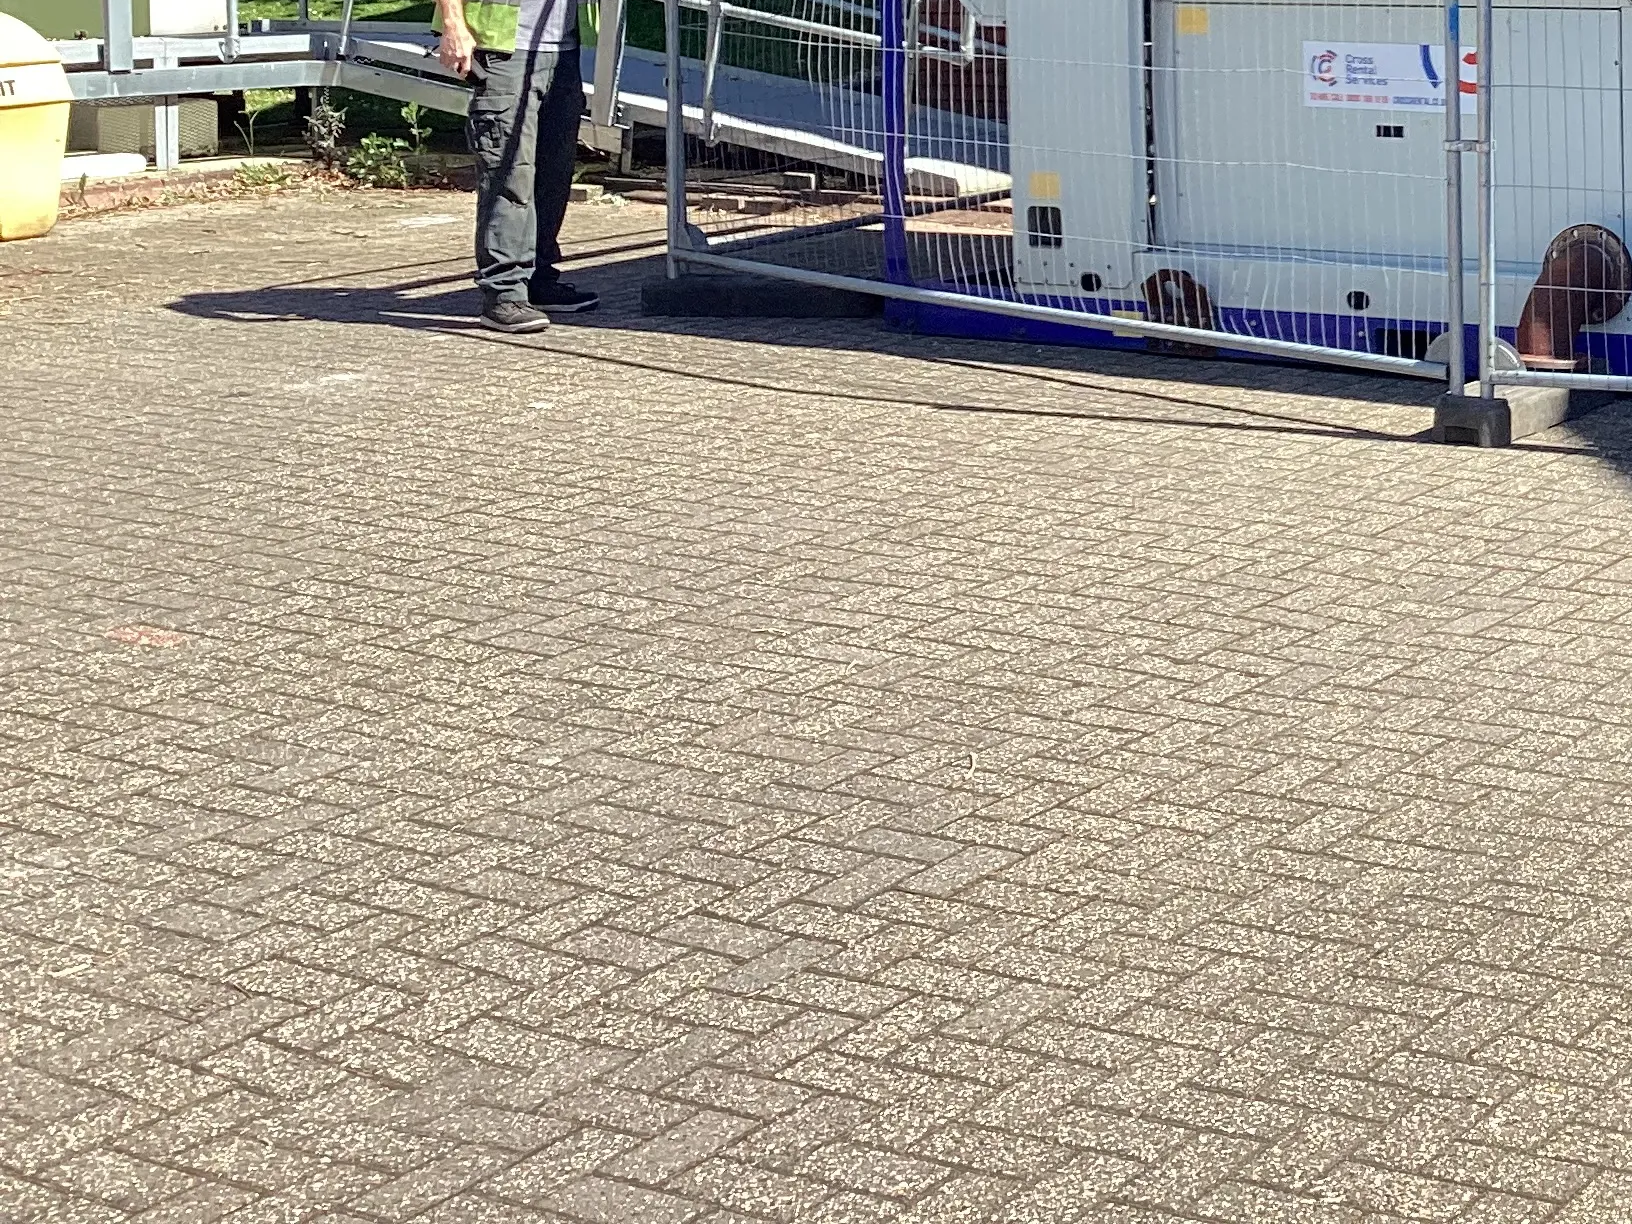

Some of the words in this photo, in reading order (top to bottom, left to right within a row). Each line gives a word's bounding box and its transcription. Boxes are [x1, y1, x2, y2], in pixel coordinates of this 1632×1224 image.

[1345, 54, 1374, 64] Cross
[1346, 64, 1377, 74] Rental
[1345, 74, 1388, 85] Services
